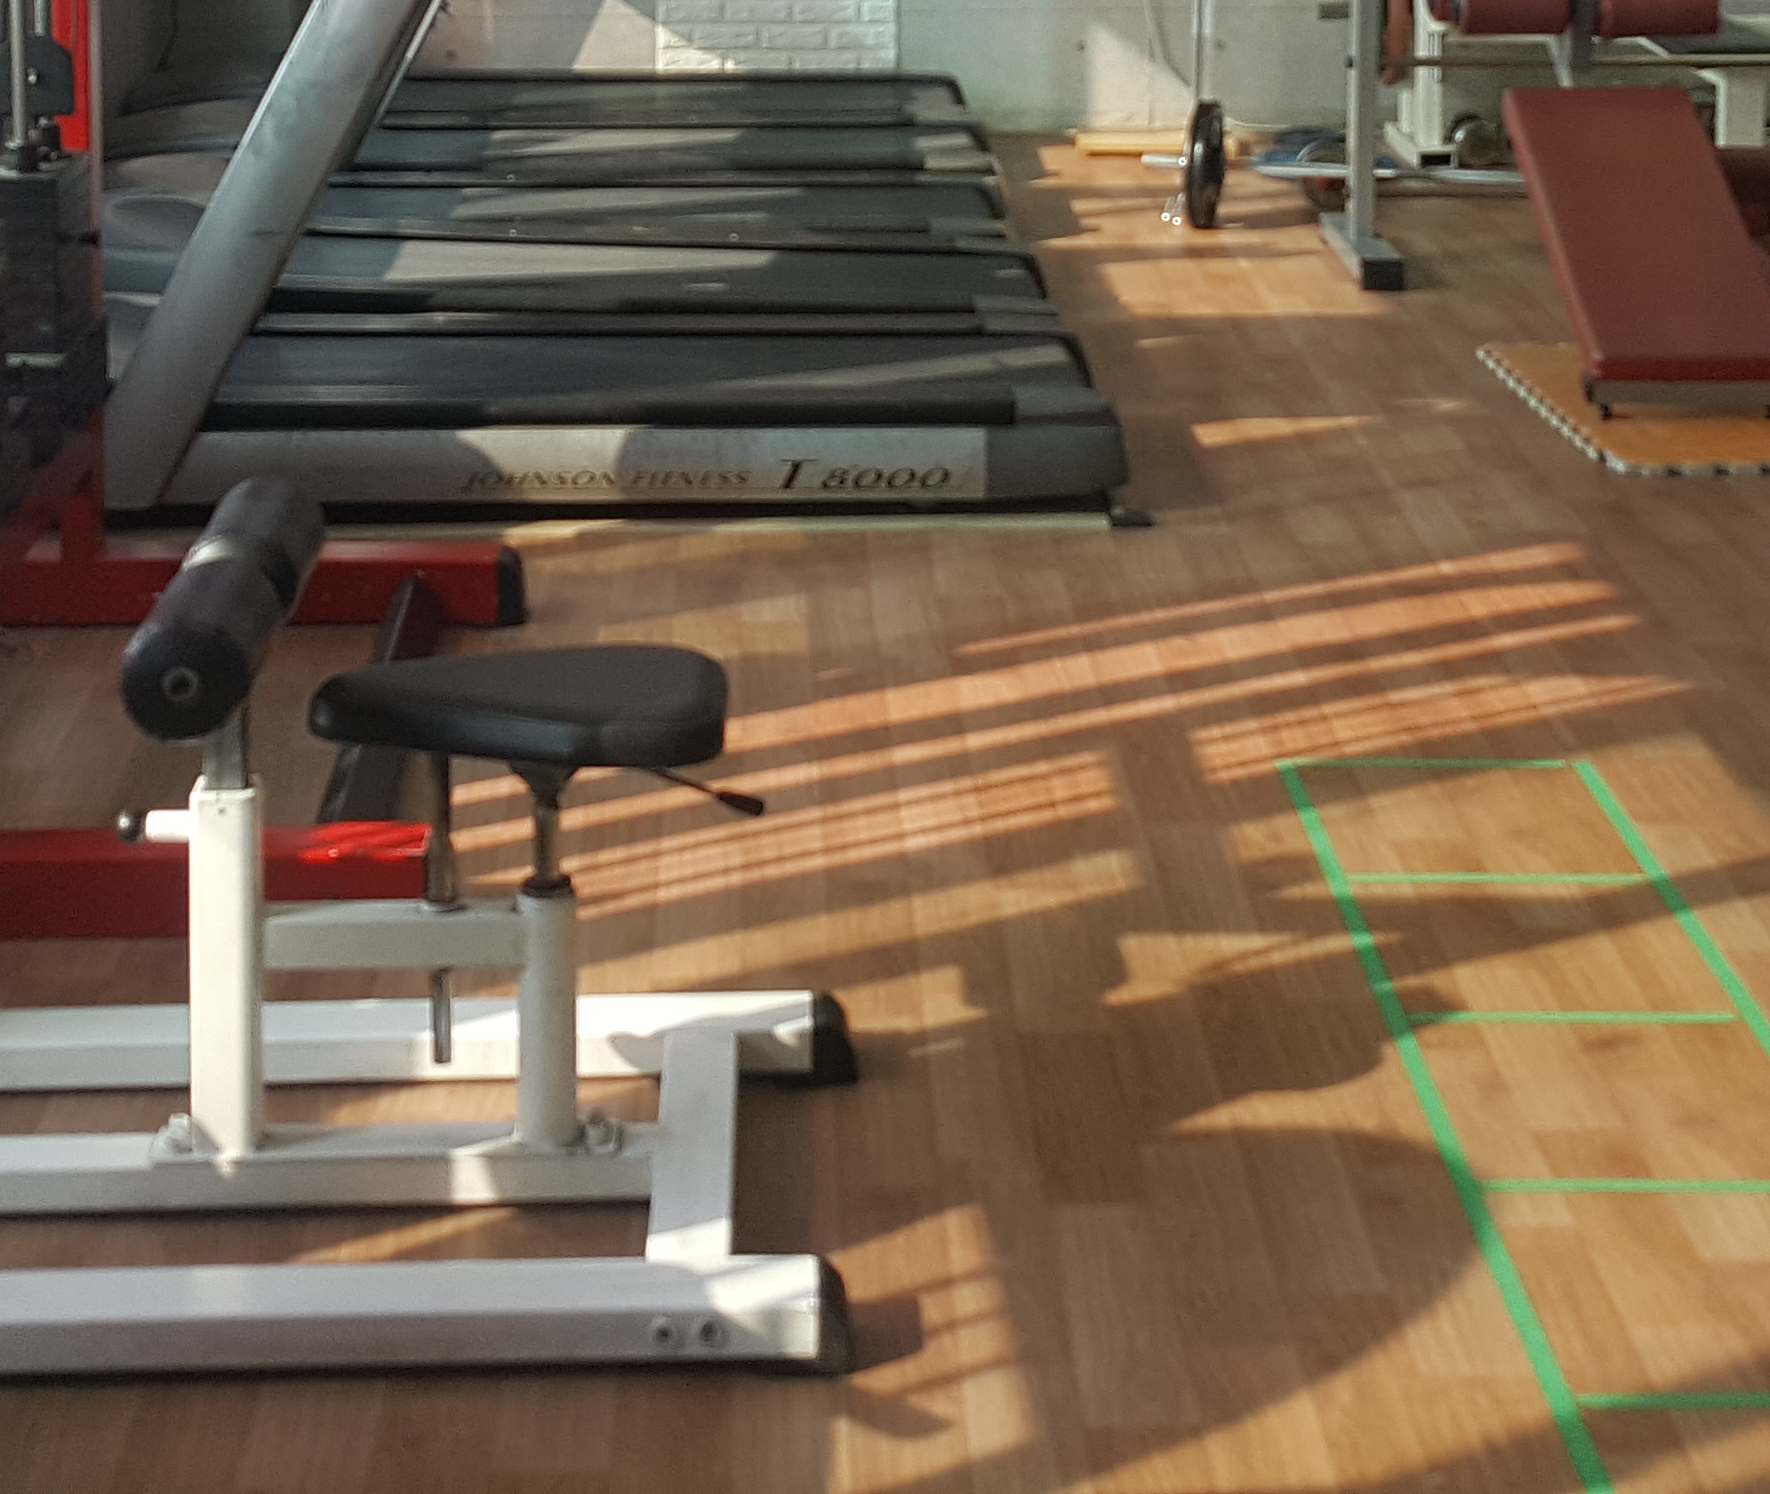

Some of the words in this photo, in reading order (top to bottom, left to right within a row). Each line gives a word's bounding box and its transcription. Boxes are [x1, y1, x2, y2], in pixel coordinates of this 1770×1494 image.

[460, 469, 616, 491] JOHNSON
[630, 469, 753, 487] FITNESS
[779, 458, 818, 489] T
[821, 466, 951, 489] 8000
